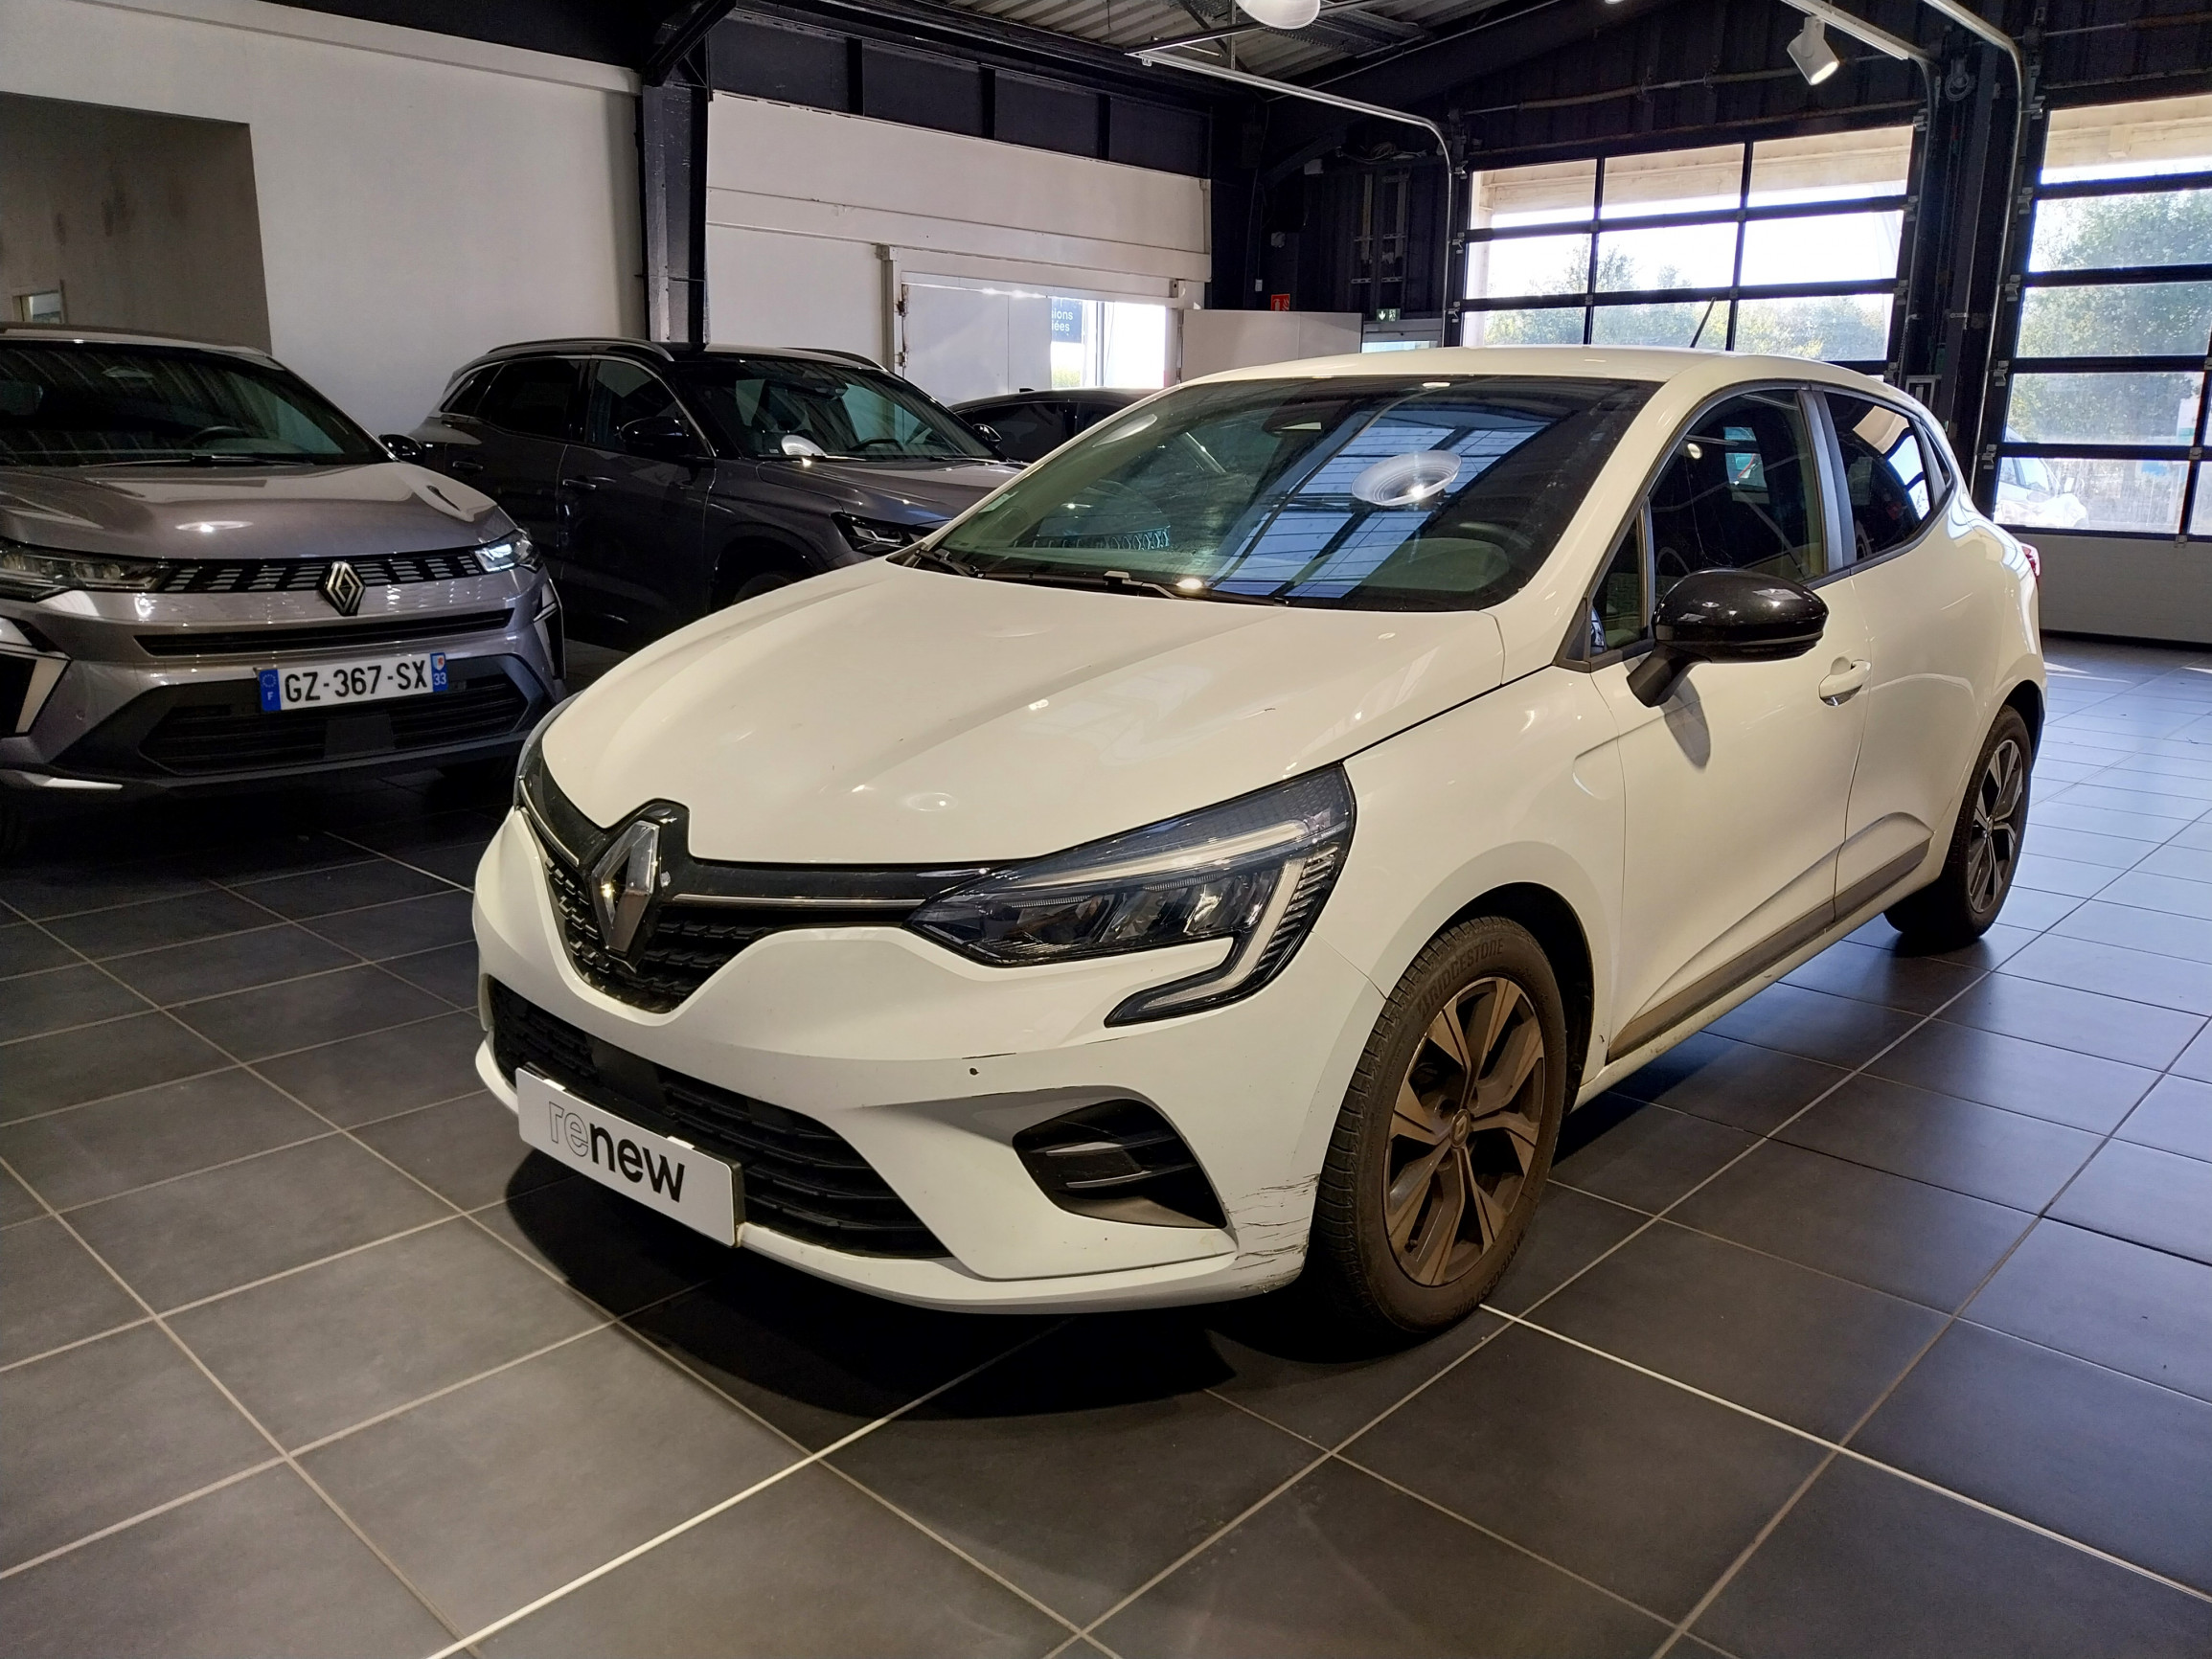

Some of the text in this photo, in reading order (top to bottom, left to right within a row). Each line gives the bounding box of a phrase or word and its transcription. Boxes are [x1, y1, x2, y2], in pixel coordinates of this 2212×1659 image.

[267, 660, 447, 702] F GZ-367-SX 33
[1419, 939, 1504, 1021] BRIDGESTONE
[548, 1102, 685, 1203] renew
